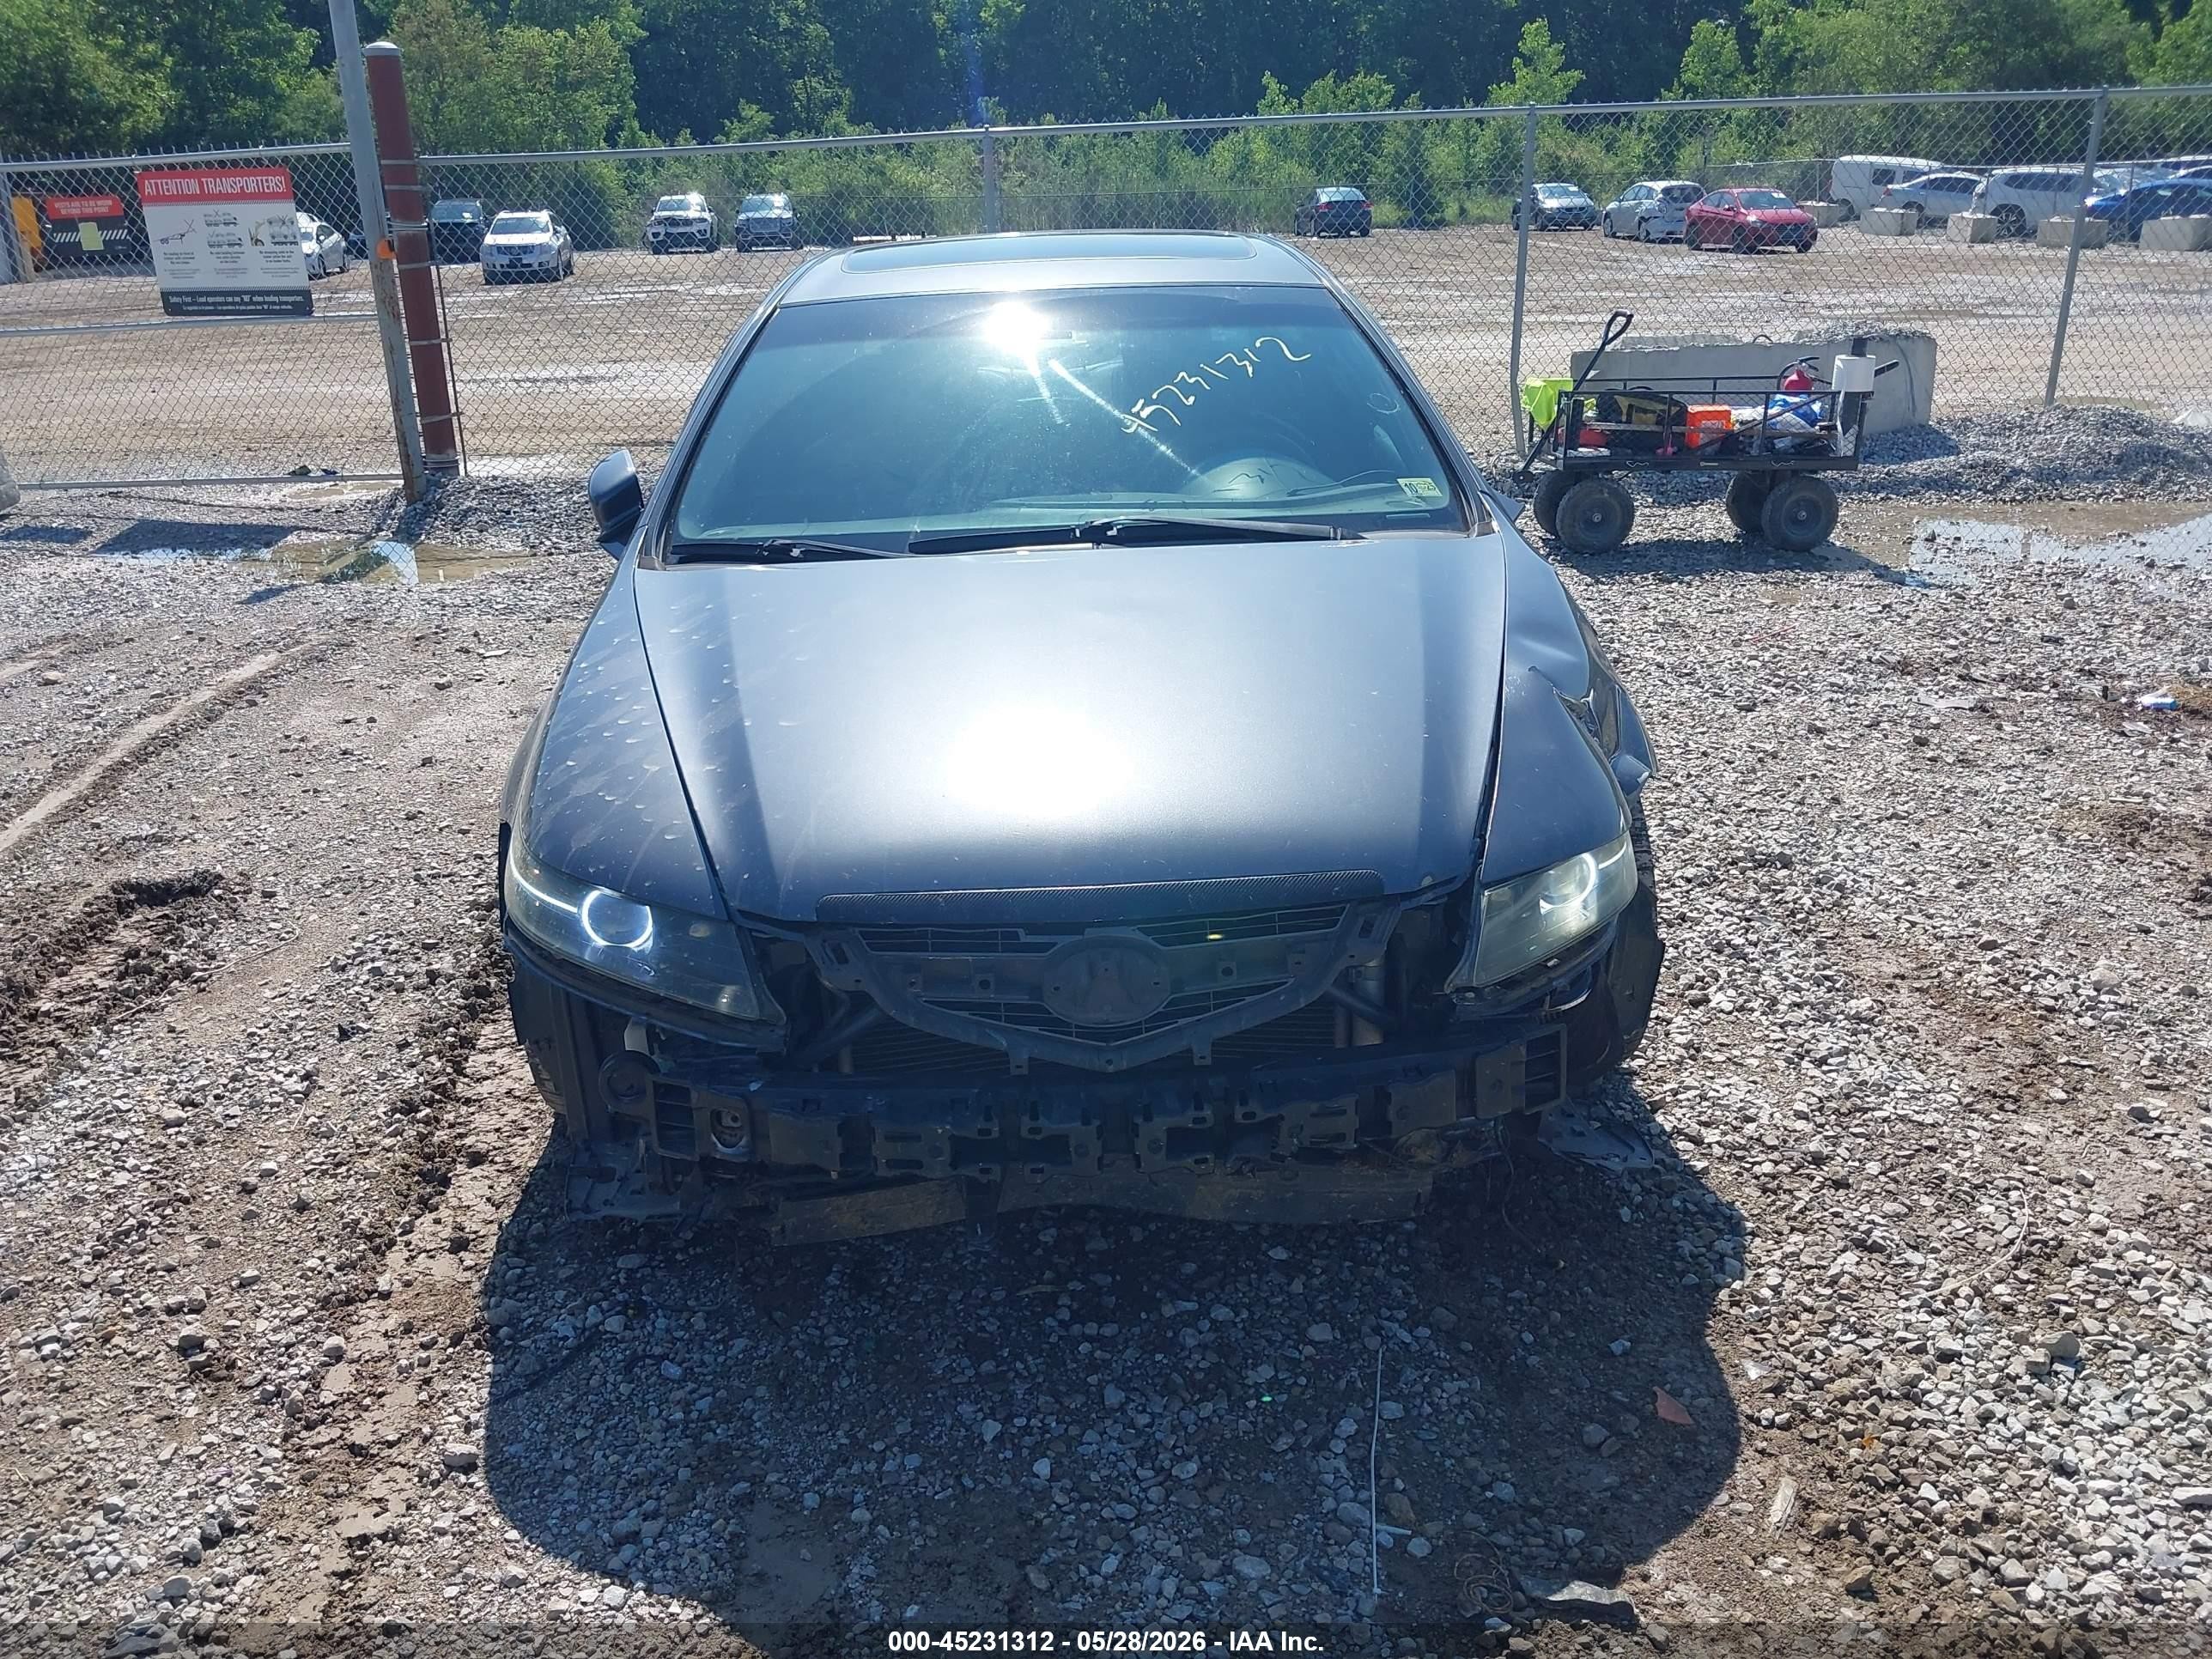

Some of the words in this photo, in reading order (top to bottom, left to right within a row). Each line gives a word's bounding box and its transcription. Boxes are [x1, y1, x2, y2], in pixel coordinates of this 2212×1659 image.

[144, 178, 200, 196] ATTENTION
[201, 175, 287, 194] TRANSPORTERS!
[1120, 336, 1312, 434] 45231312
[1404, 482, 1419, 494] 10
